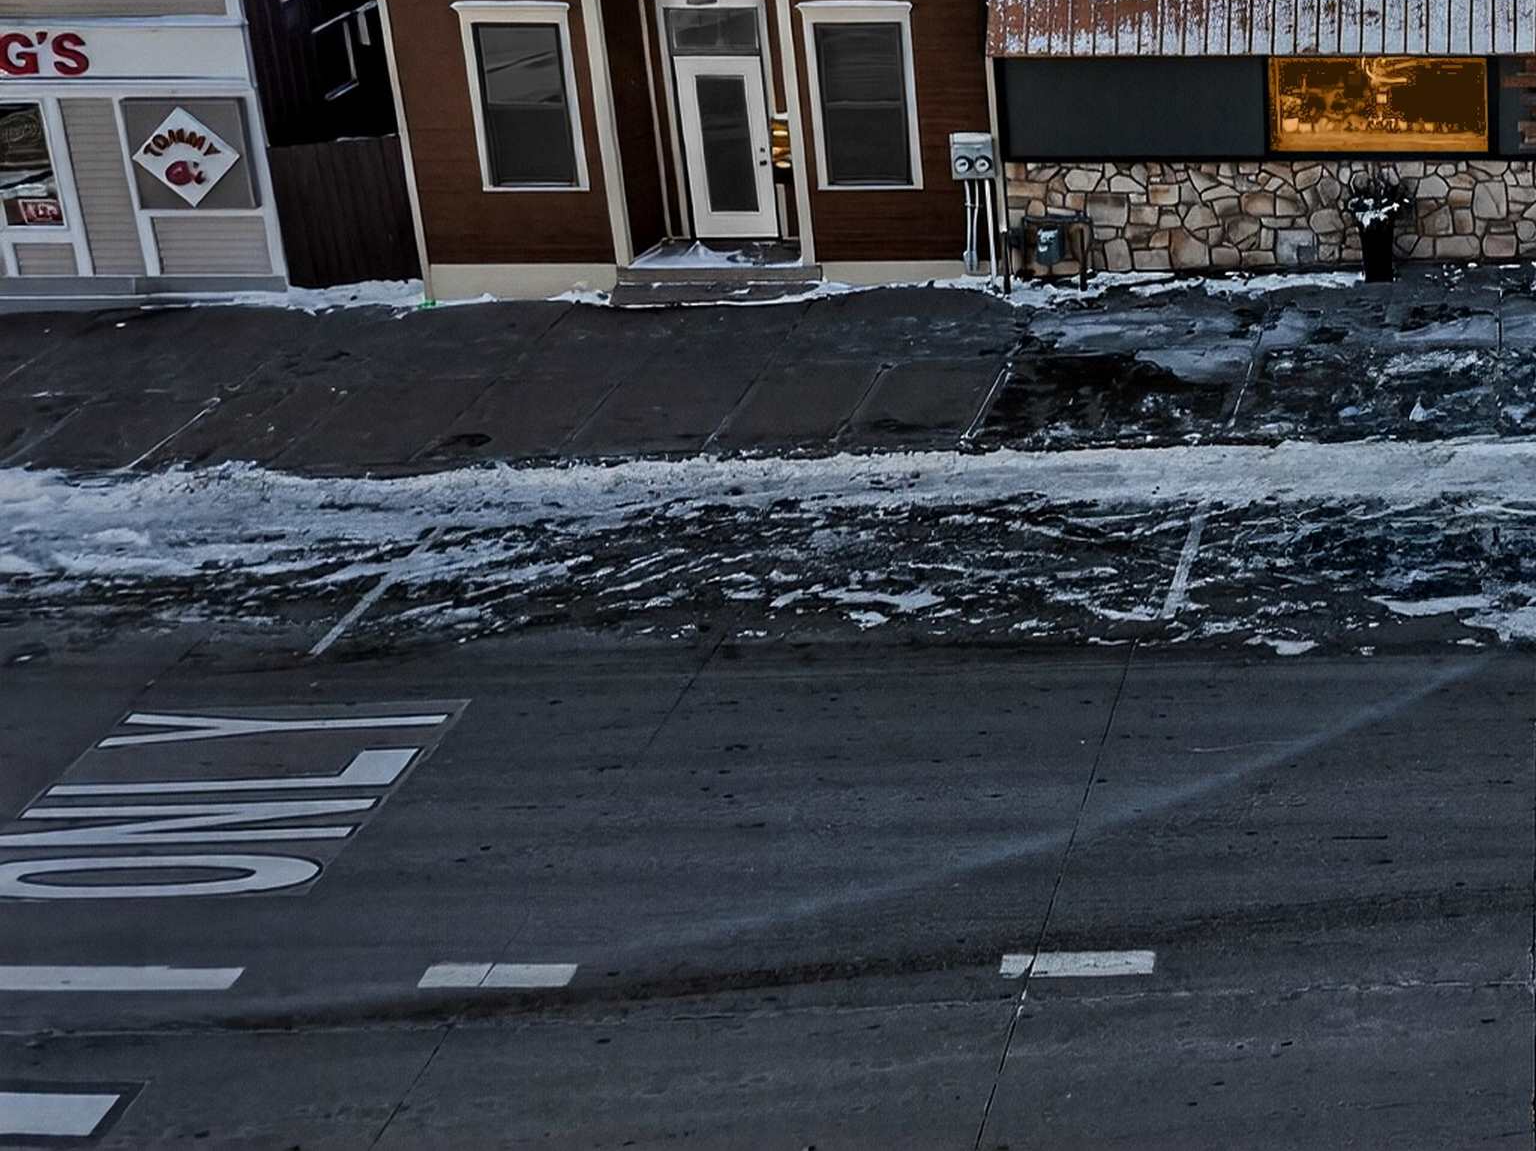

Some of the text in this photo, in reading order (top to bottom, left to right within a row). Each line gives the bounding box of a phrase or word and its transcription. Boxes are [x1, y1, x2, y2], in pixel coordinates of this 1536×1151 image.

[0, 31, 90, 76] G'S
[143, 128, 222, 157] TOMMY
[0, 713, 450, 898] ONLY
